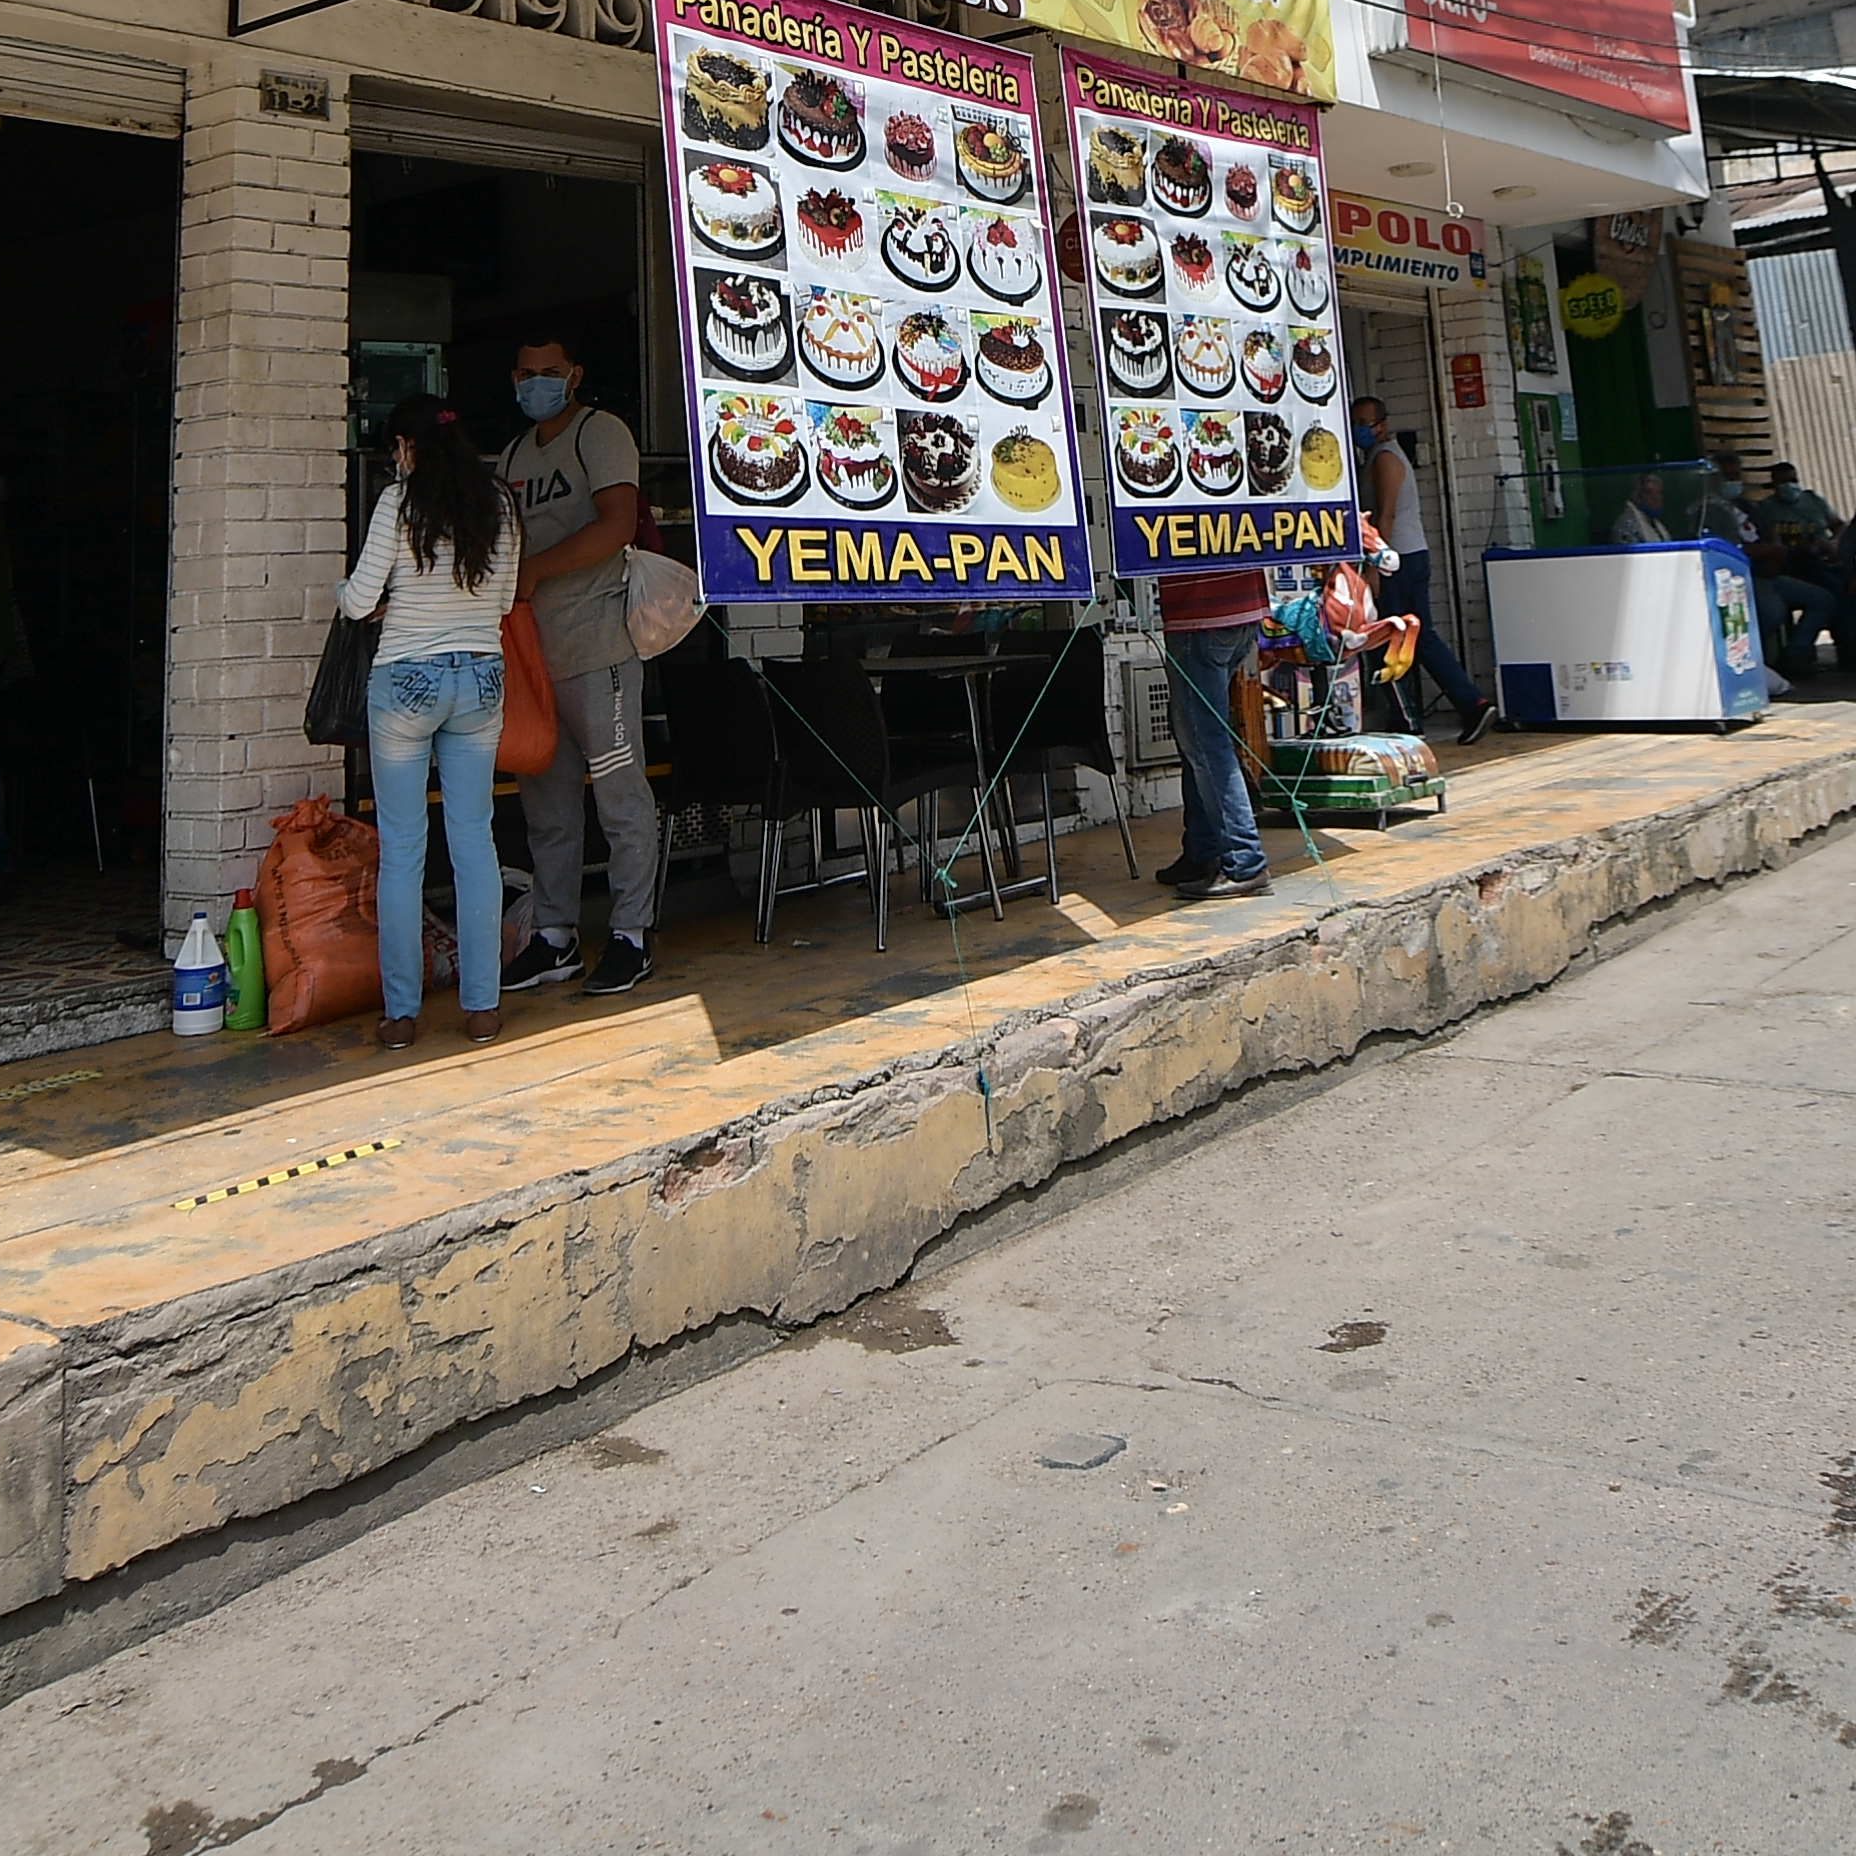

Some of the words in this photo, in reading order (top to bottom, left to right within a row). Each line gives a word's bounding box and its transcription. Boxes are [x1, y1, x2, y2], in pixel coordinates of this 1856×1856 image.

[847, 24, 872, 67] Y
[879, 34, 1020, 106] Pastelería
[1196, 95, 1212, 130] Y
[1216, 100, 1311, 150] Pastelería
[1337, 200, 1472, 257] POLO
[735, 526, 1066, 583] YEMA-PAN
[1134, 510, 1348, 559] YEMA-PAN
